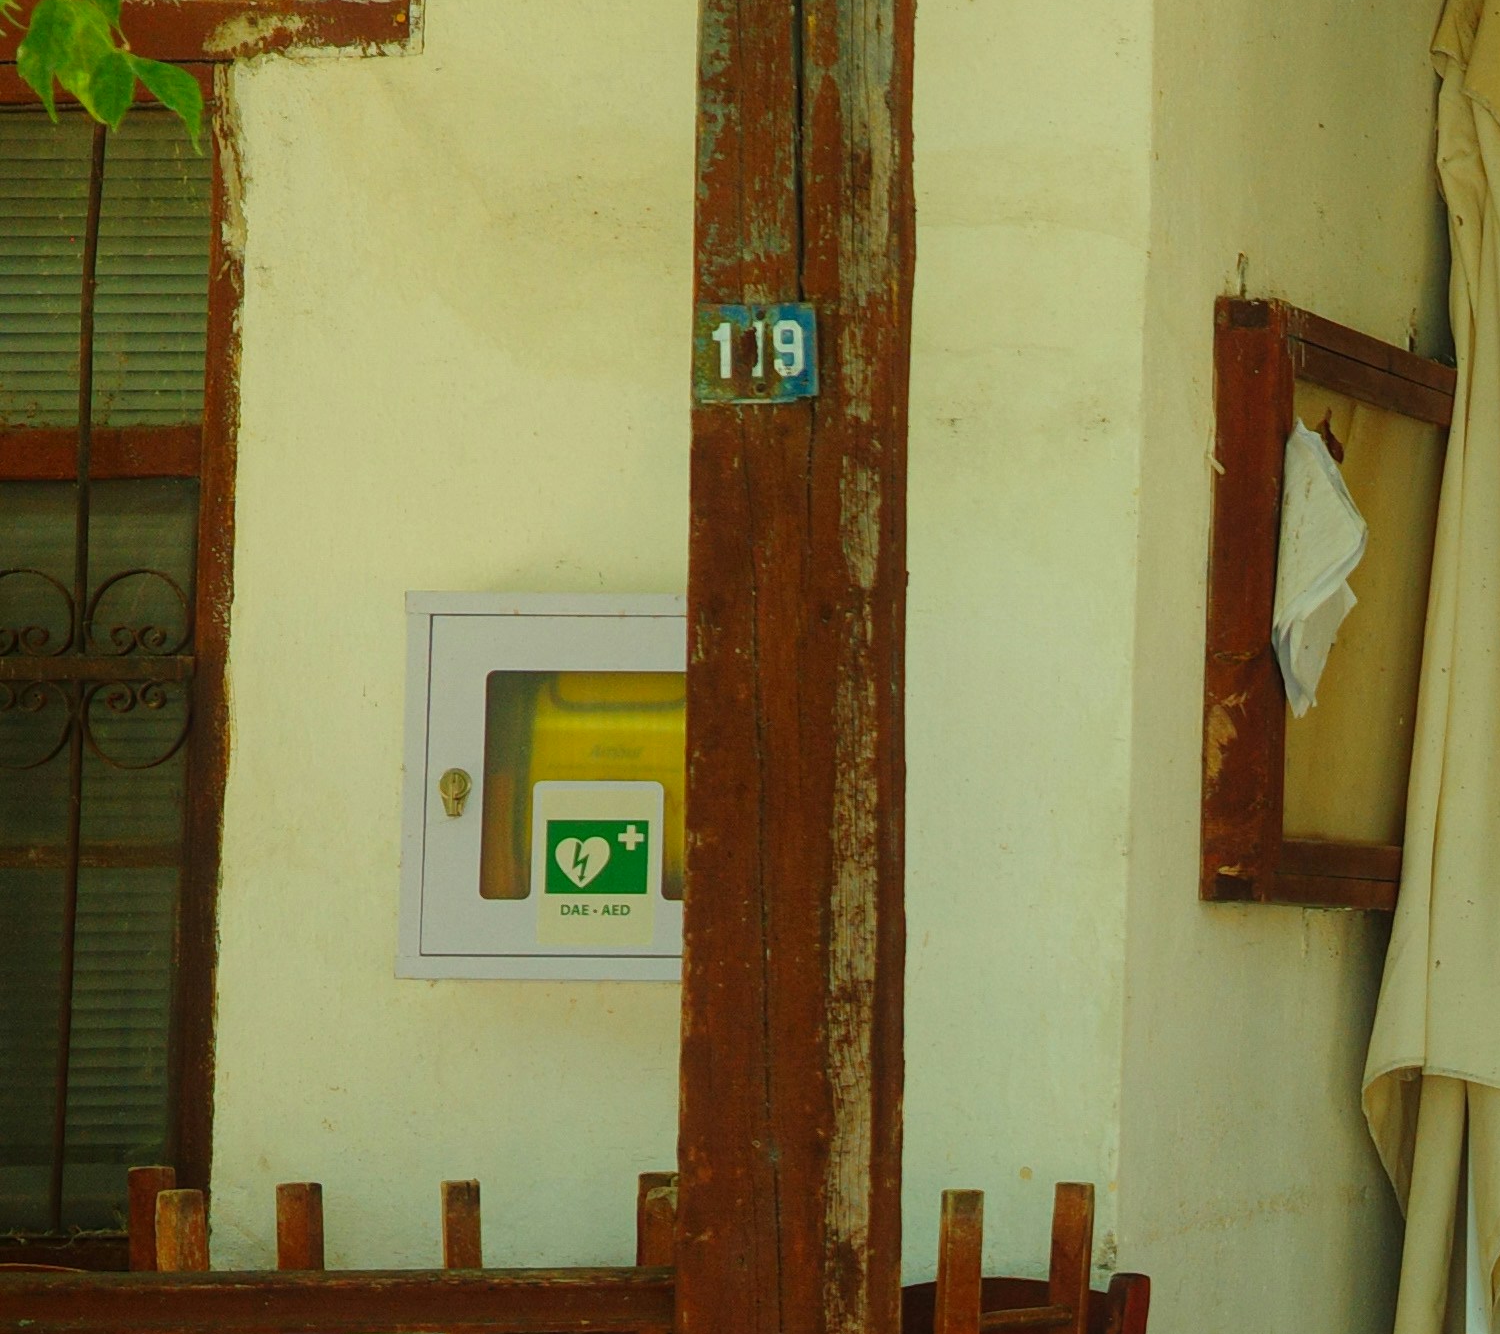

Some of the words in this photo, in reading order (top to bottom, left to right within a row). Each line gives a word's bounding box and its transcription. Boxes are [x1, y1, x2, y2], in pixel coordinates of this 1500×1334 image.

[712, 319, 804, 379] 119
[560, 904, 590, 916] DAE
[601, 904, 631, 916] AED
